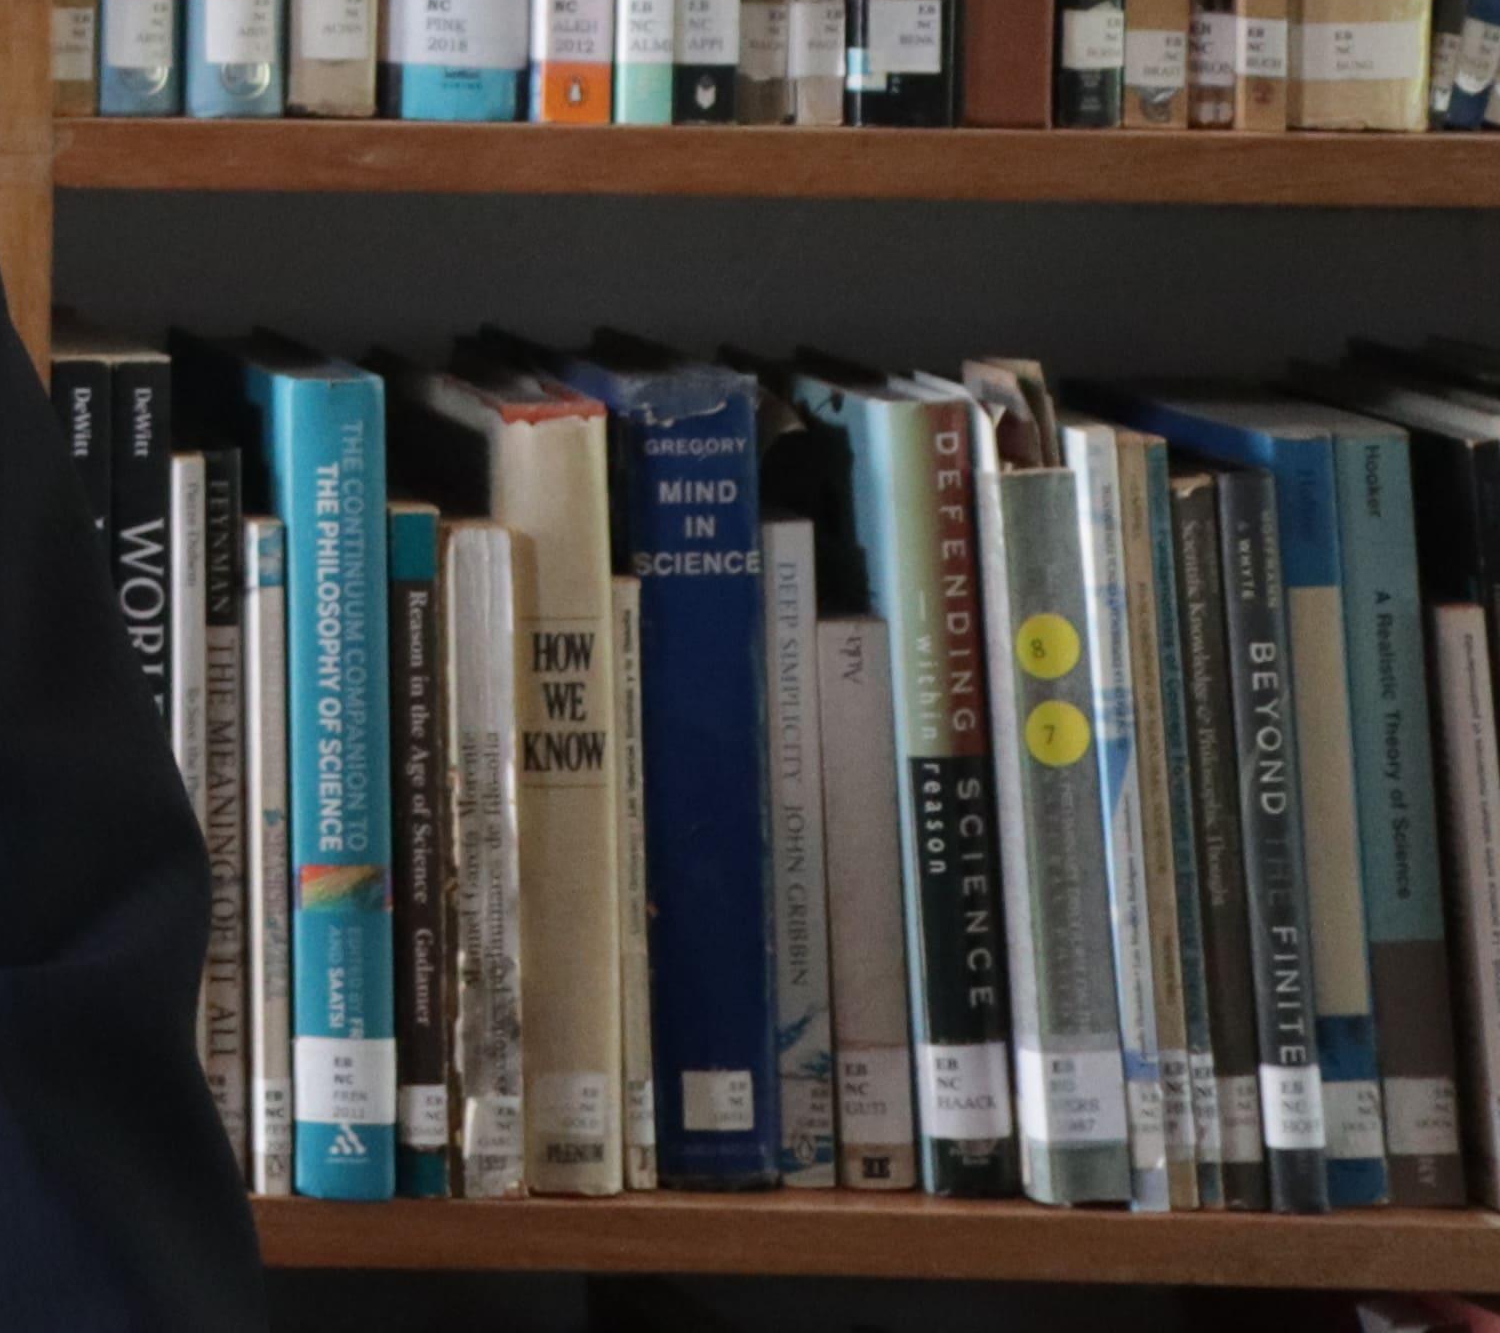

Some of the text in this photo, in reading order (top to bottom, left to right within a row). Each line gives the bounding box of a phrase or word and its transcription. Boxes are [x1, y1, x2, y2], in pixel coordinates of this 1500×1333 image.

[72, 386, 93, 458] DeWitt
[133, 386, 154, 458] DeWitt
[659, 480, 738, 504] MIND
[684, 517, 715, 538] IN
[632, 551, 762, 575] SCIENCE
[531, 632, 594, 674] HOW
[542, 683, 587, 721] WE
[934, 432, 995, 1010] DEFENDING SCIENCE
[522, 732, 607, 772] KNOW
[405, 590, 435, 1027] Reason in the Age of Science Gadamer
[919, 763, 949, 875] reason
